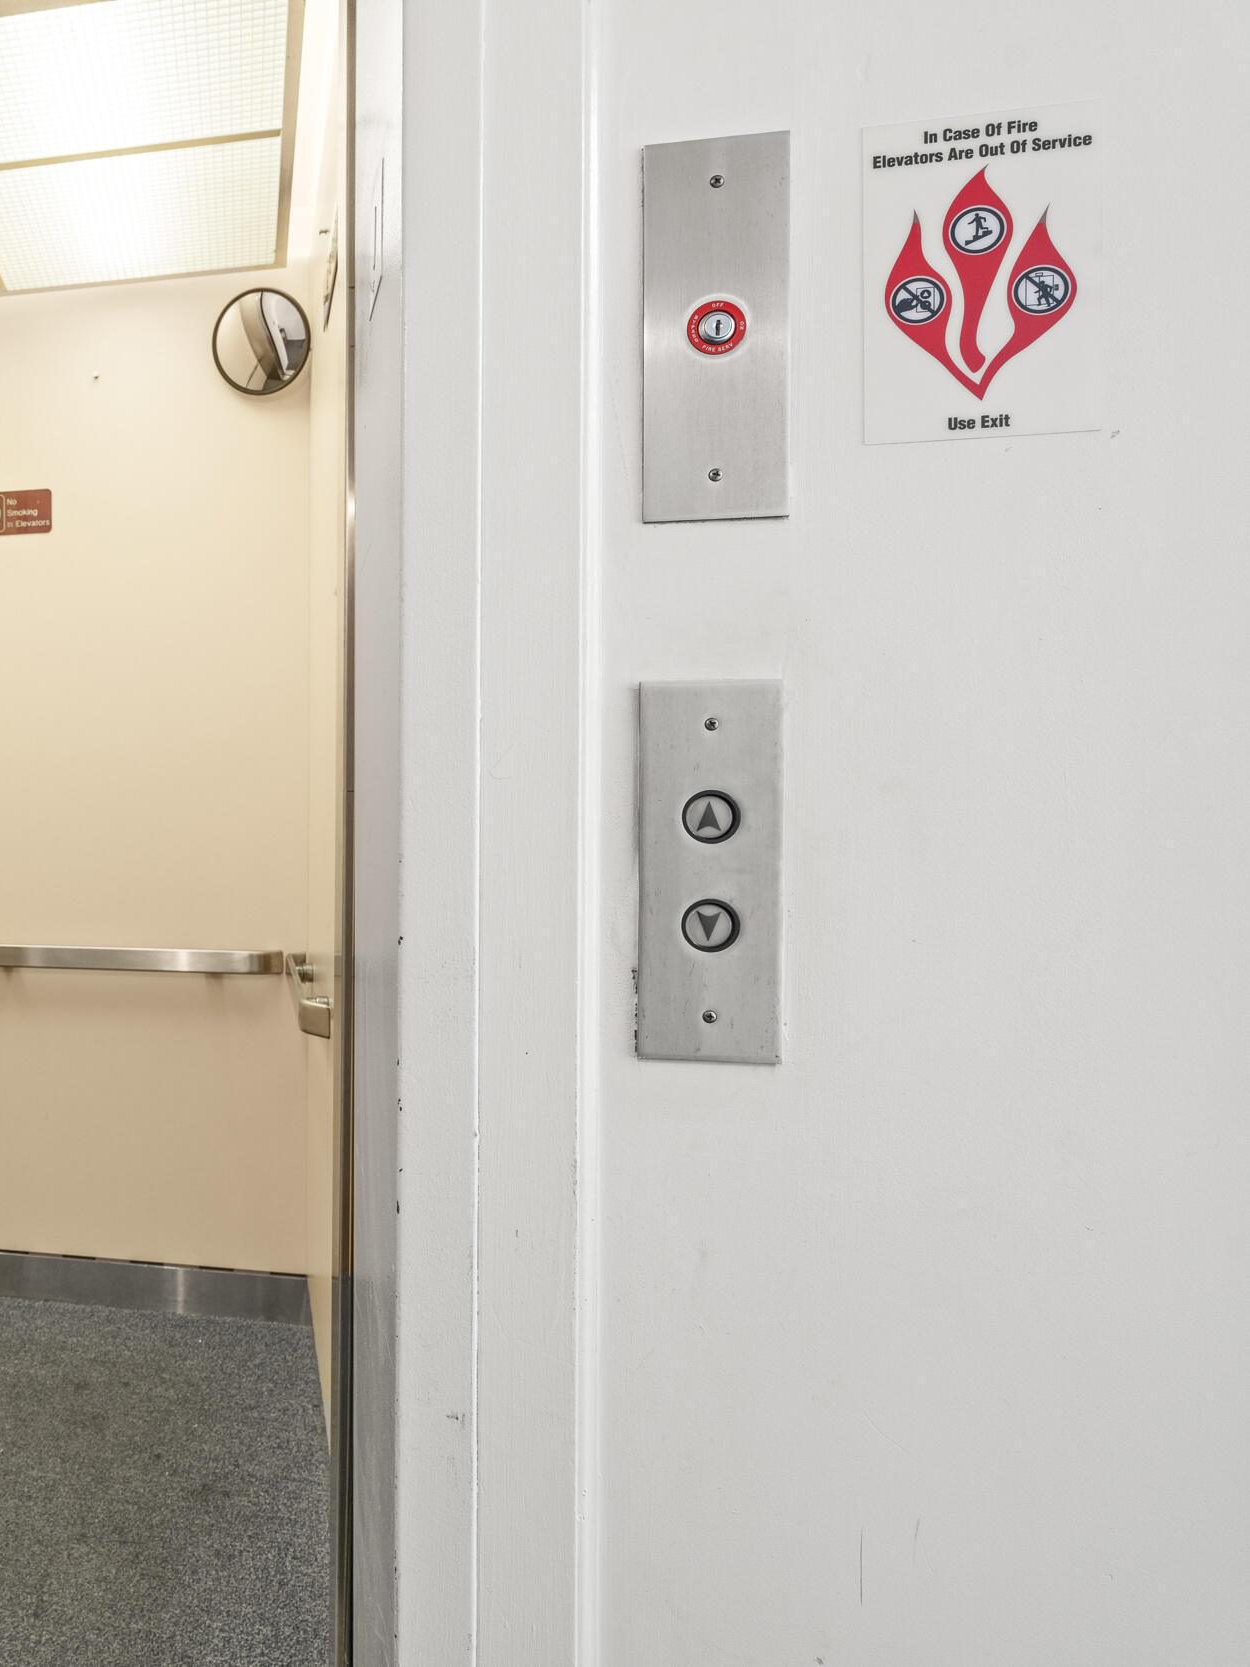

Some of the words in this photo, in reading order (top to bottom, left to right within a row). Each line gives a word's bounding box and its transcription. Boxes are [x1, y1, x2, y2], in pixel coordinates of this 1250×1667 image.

[923, 131, 938, 144] In
[942, 127, 980, 142] Case
[985, 122, 1002, 137] Of
[1007, 120, 1038, 135] Fire
[872, 152, 944, 169] Elevators
[947, 147, 974, 161] Are
[979, 142, 1005, 157] Out
[1010, 139, 1027, 154] Of
[1031, 134, 1092, 152] Service
[948, 416, 976, 430] Use
[981, 414, 1010, 429] Exit
[6, 508, 38, 517] Smoking
[15, 519, 50, 528] Elevators
